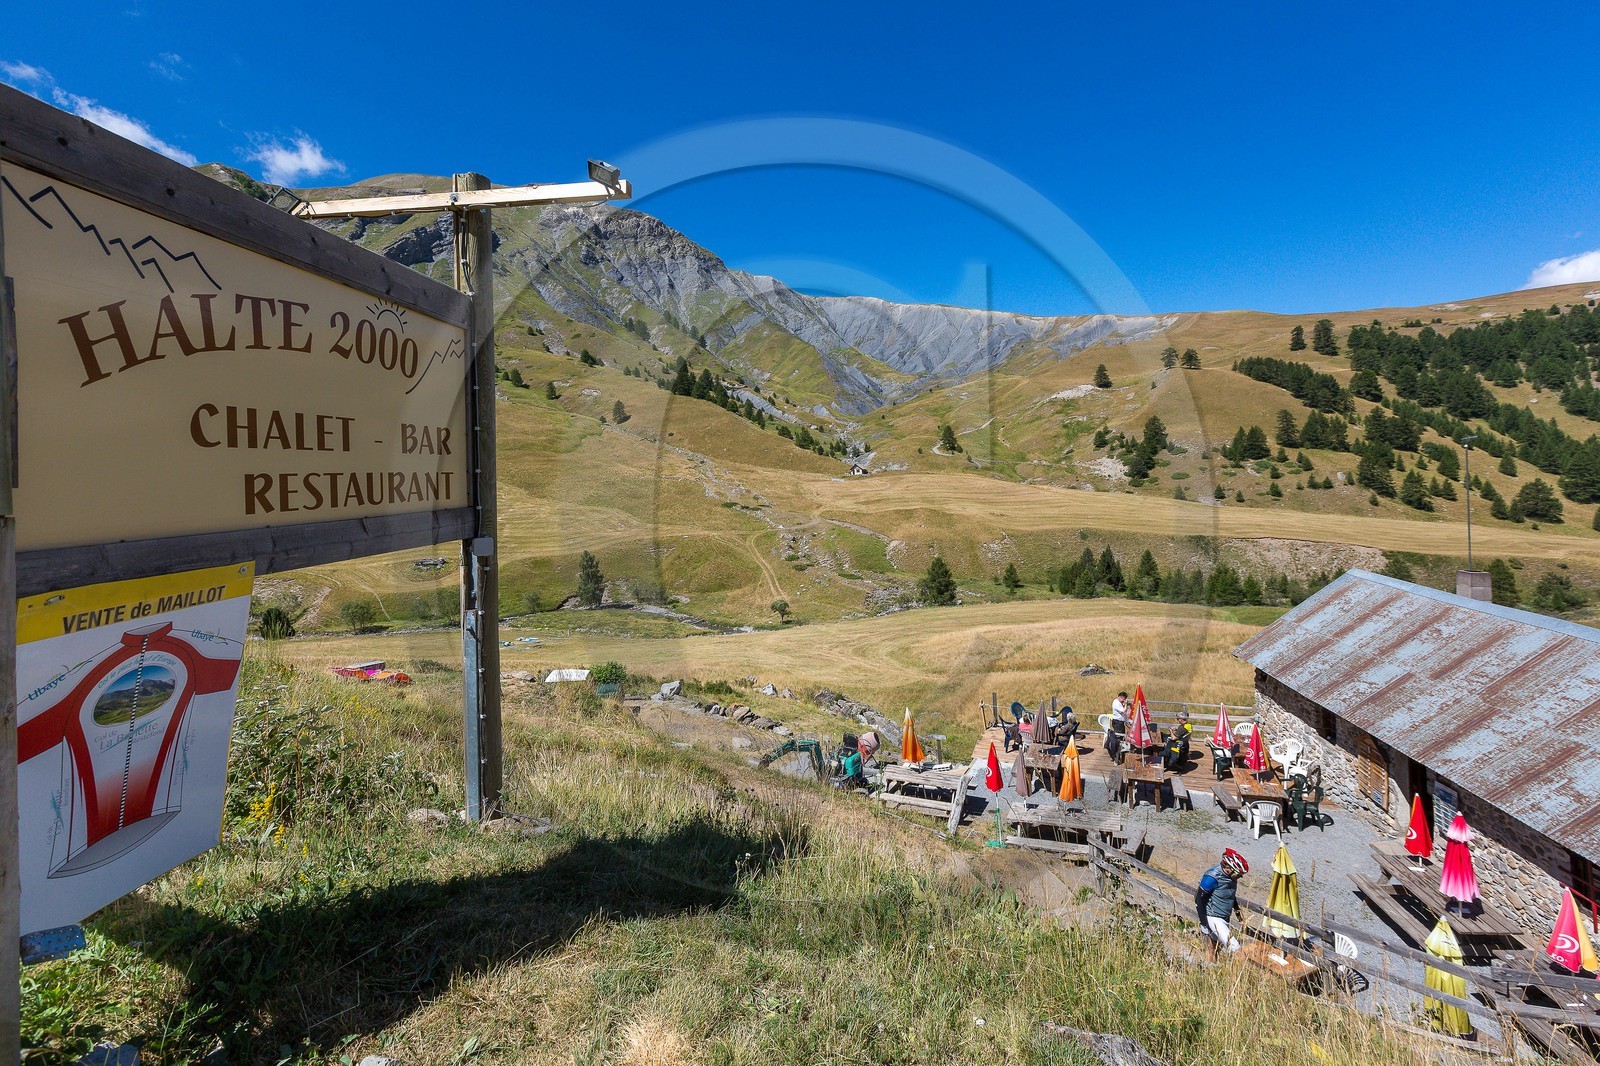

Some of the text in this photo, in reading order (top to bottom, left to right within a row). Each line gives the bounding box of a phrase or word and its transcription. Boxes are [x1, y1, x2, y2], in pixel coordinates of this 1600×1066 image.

[58, 293, 418, 388] HALTE 2000
[190, 403, 355, 452] CHALET
[401, 423, 452, 456] BAR
[244, 472, 454, 515] RESTAURANT
[63, 585, 226, 634] VENTE de MAILLOT
[191, 629, 214, 642] Ubaye
[28, 674, 66, 700] Ubaye
